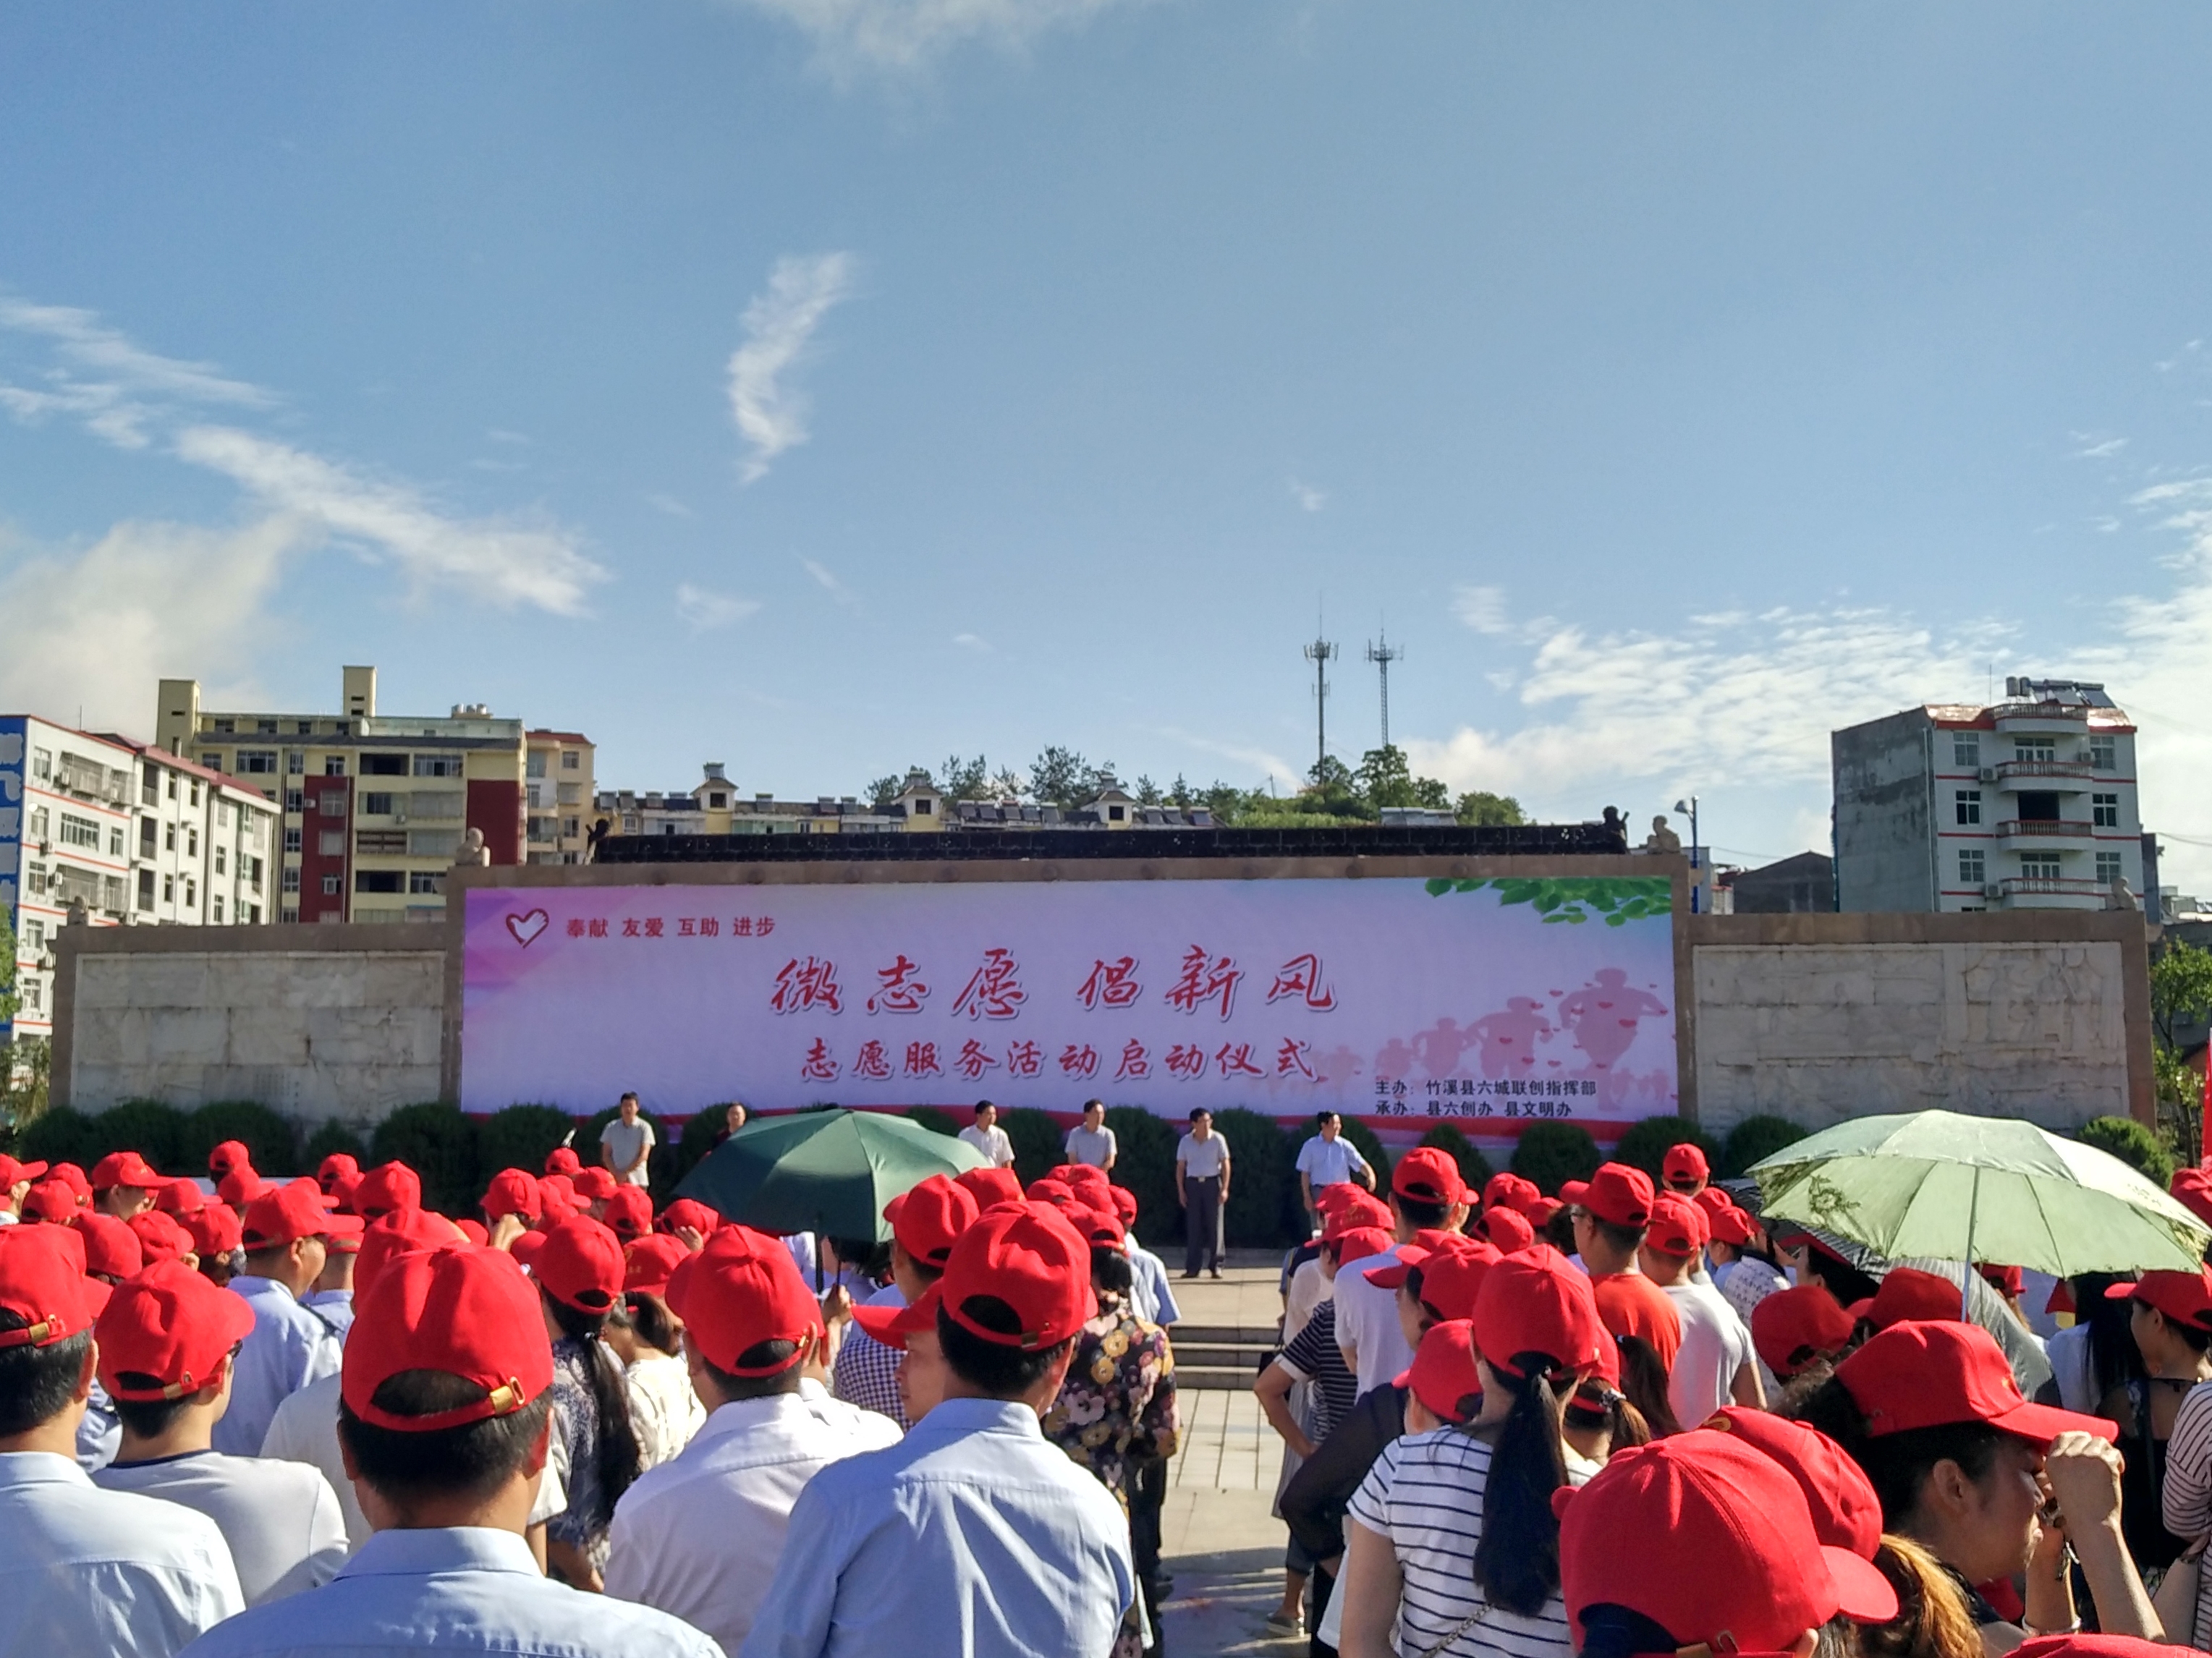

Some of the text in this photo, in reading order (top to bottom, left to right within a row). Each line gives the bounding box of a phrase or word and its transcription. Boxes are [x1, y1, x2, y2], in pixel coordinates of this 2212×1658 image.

[567, 916, 776, 938] 奉献 友爱 互助 进步
[800, 1036, 1315, 1079] 志愿服务活动启动仪式
